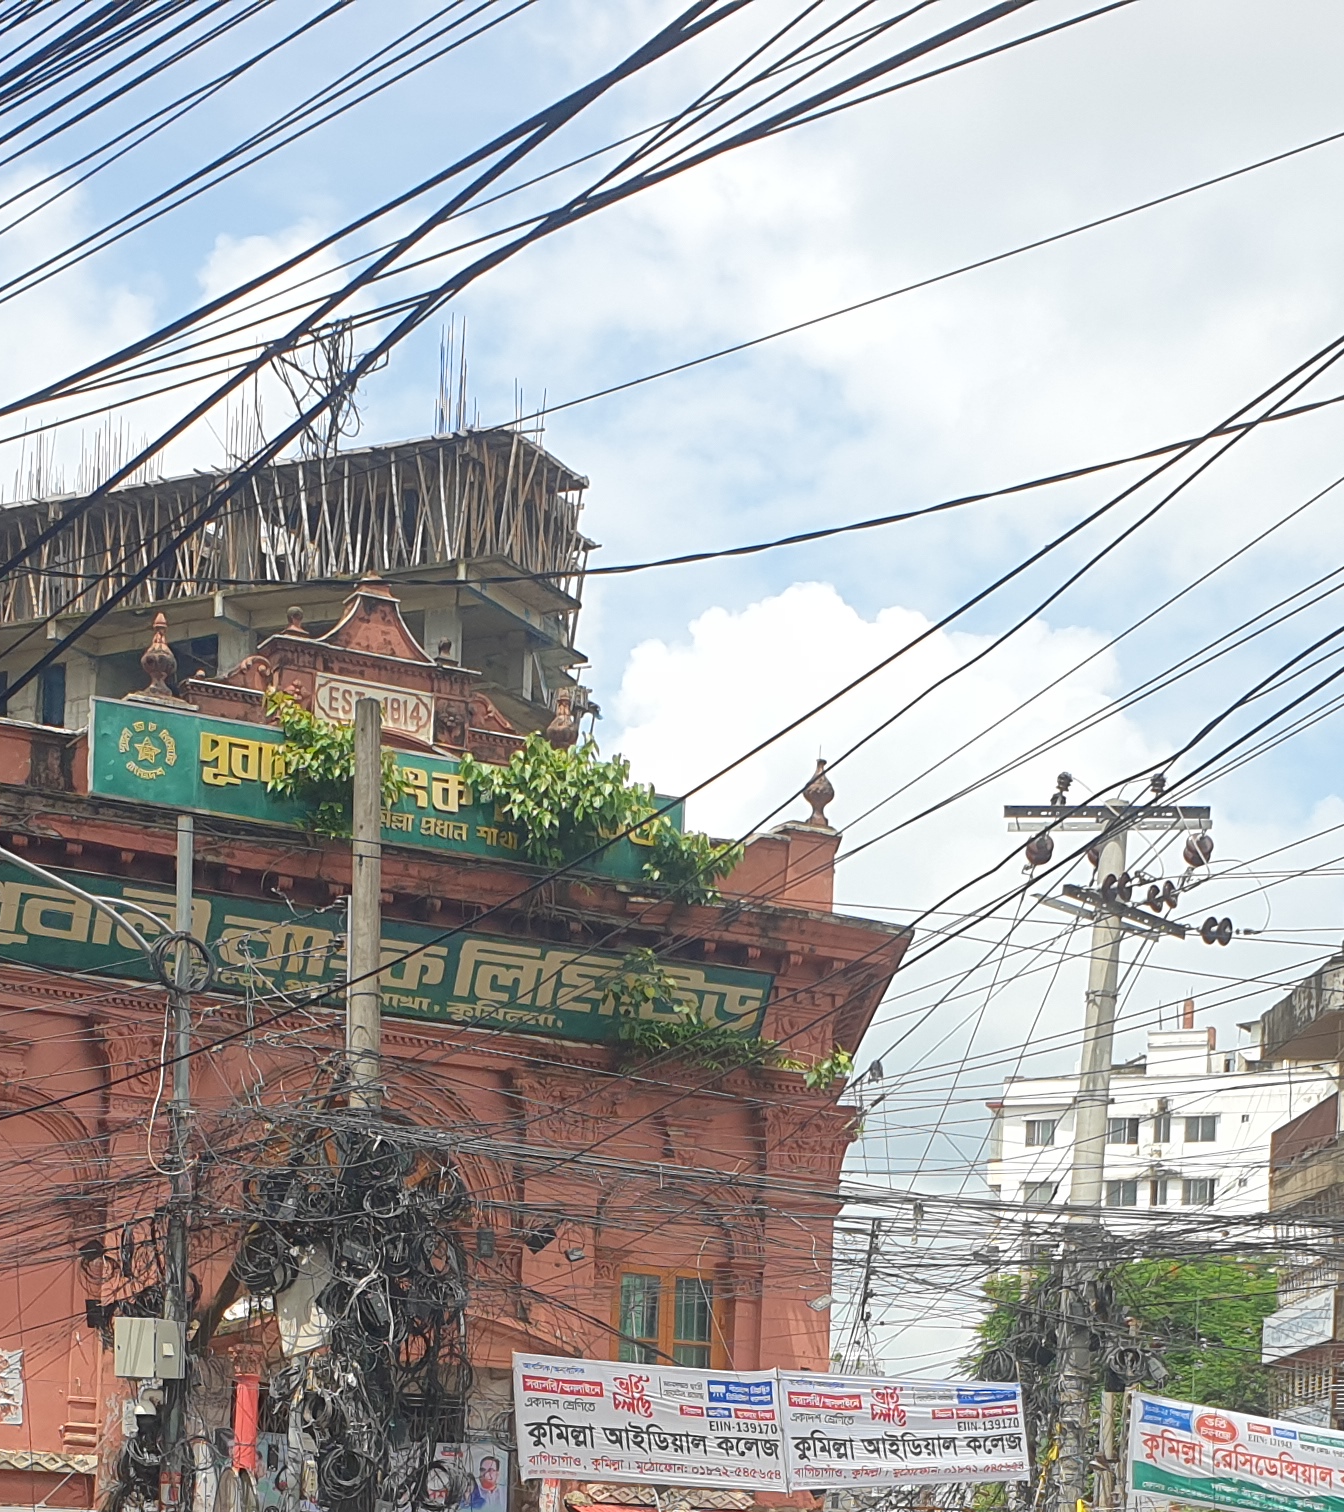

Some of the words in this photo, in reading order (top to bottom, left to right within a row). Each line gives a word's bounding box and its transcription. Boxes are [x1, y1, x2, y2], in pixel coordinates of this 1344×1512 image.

[420, 815, 469, 841] প্রধান
[524, 1398, 560, 1410] একাদশ
[524, 1415, 595, 1450] কুমিল্লা
[602, 1421, 707, 1456] আইডিয়াল
[714, 1435, 781, 1461] কলেজ
[709, 1421, 778, 1435] EIIN-139170
[792, 1430, 855, 1461] কুমিল্লা
[860, 1431, 957, 1461] আইডিয়াল
[964, 1432, 1023, 1456] কলেজ
[1140, 1428, 1203, 1466] কুমিল্লা
